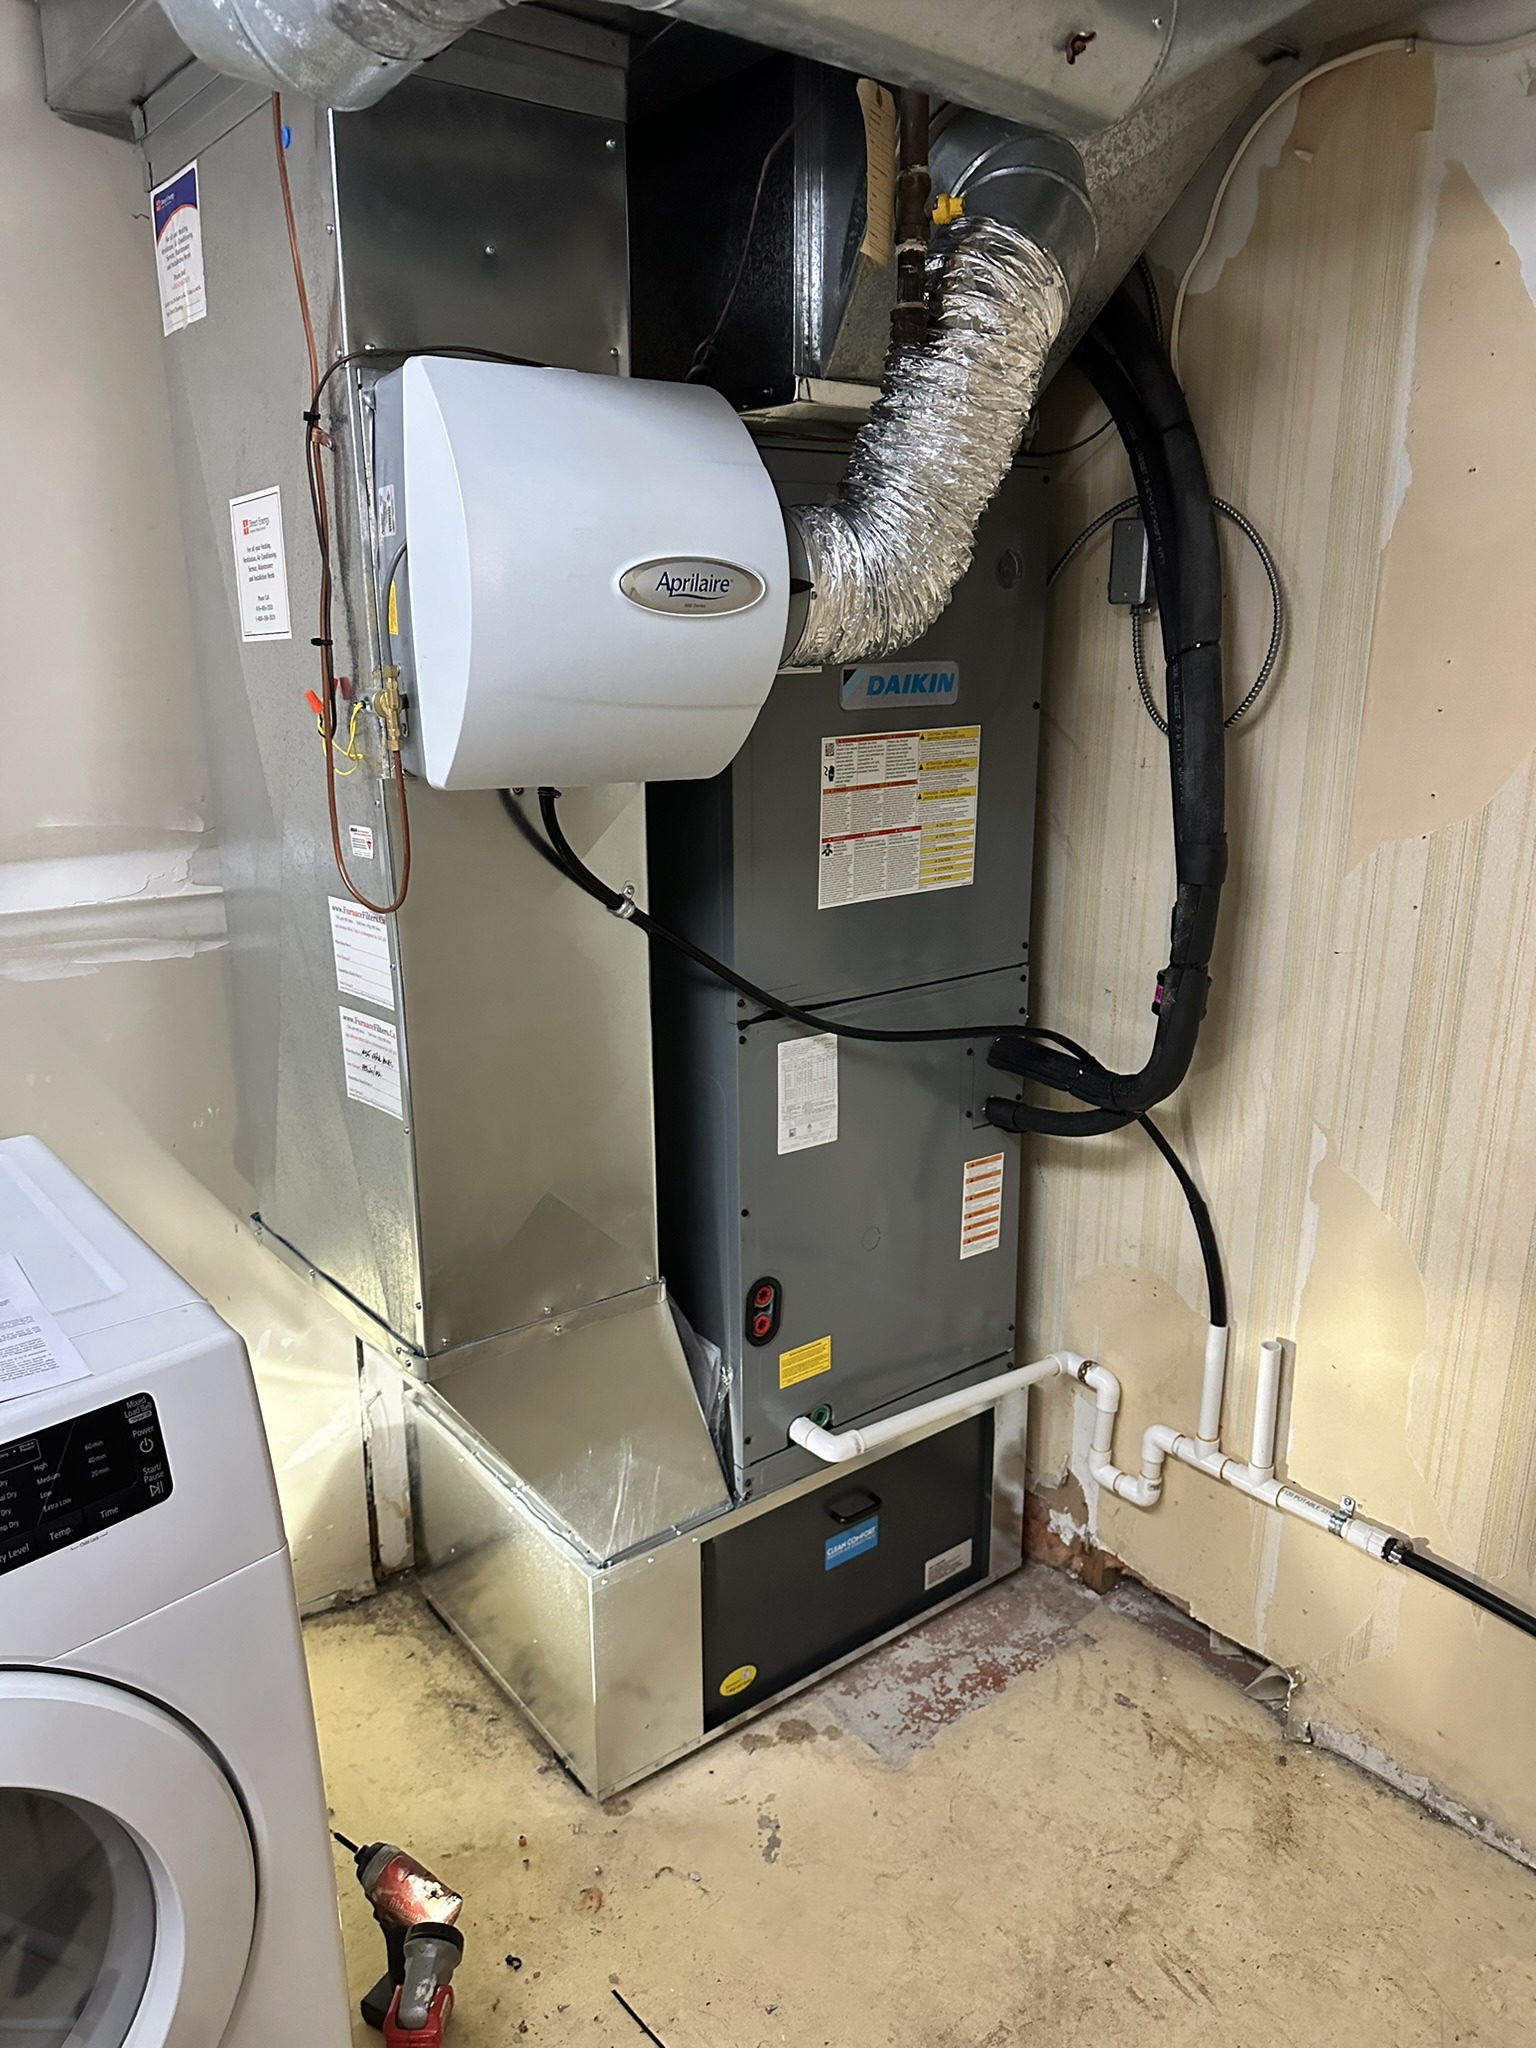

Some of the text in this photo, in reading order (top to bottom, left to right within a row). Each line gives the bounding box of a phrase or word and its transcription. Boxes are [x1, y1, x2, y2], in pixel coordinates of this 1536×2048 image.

[655, 571, 730, 598] Aprilaire
[867, 672, 955, 696] DAIKIN
[126, 1395, 147, 1409] Mixed
[124, 1406, 140, 1419] Load
[132, 1425, 154, 1438] Power
[33, 1461, 48, 1472] High
[36, 1472, 61, 1485] Medium
[143, 1471, 164, 1483] Pause
[6, 1491, 17, 1499] Dry
[1294, 1494, 1321, 1511] POTABLE
[0, 1508, 11, 1516] Dry
[100, 1506, 119, 1519] Time
[8, 1520, 19, 1528] Dry
[49, 1527, 74, 1540] Temp.
[826, 1526, 876, 1556] CLEAN COMFORT
[8, 1543, 30, 1559] Level
